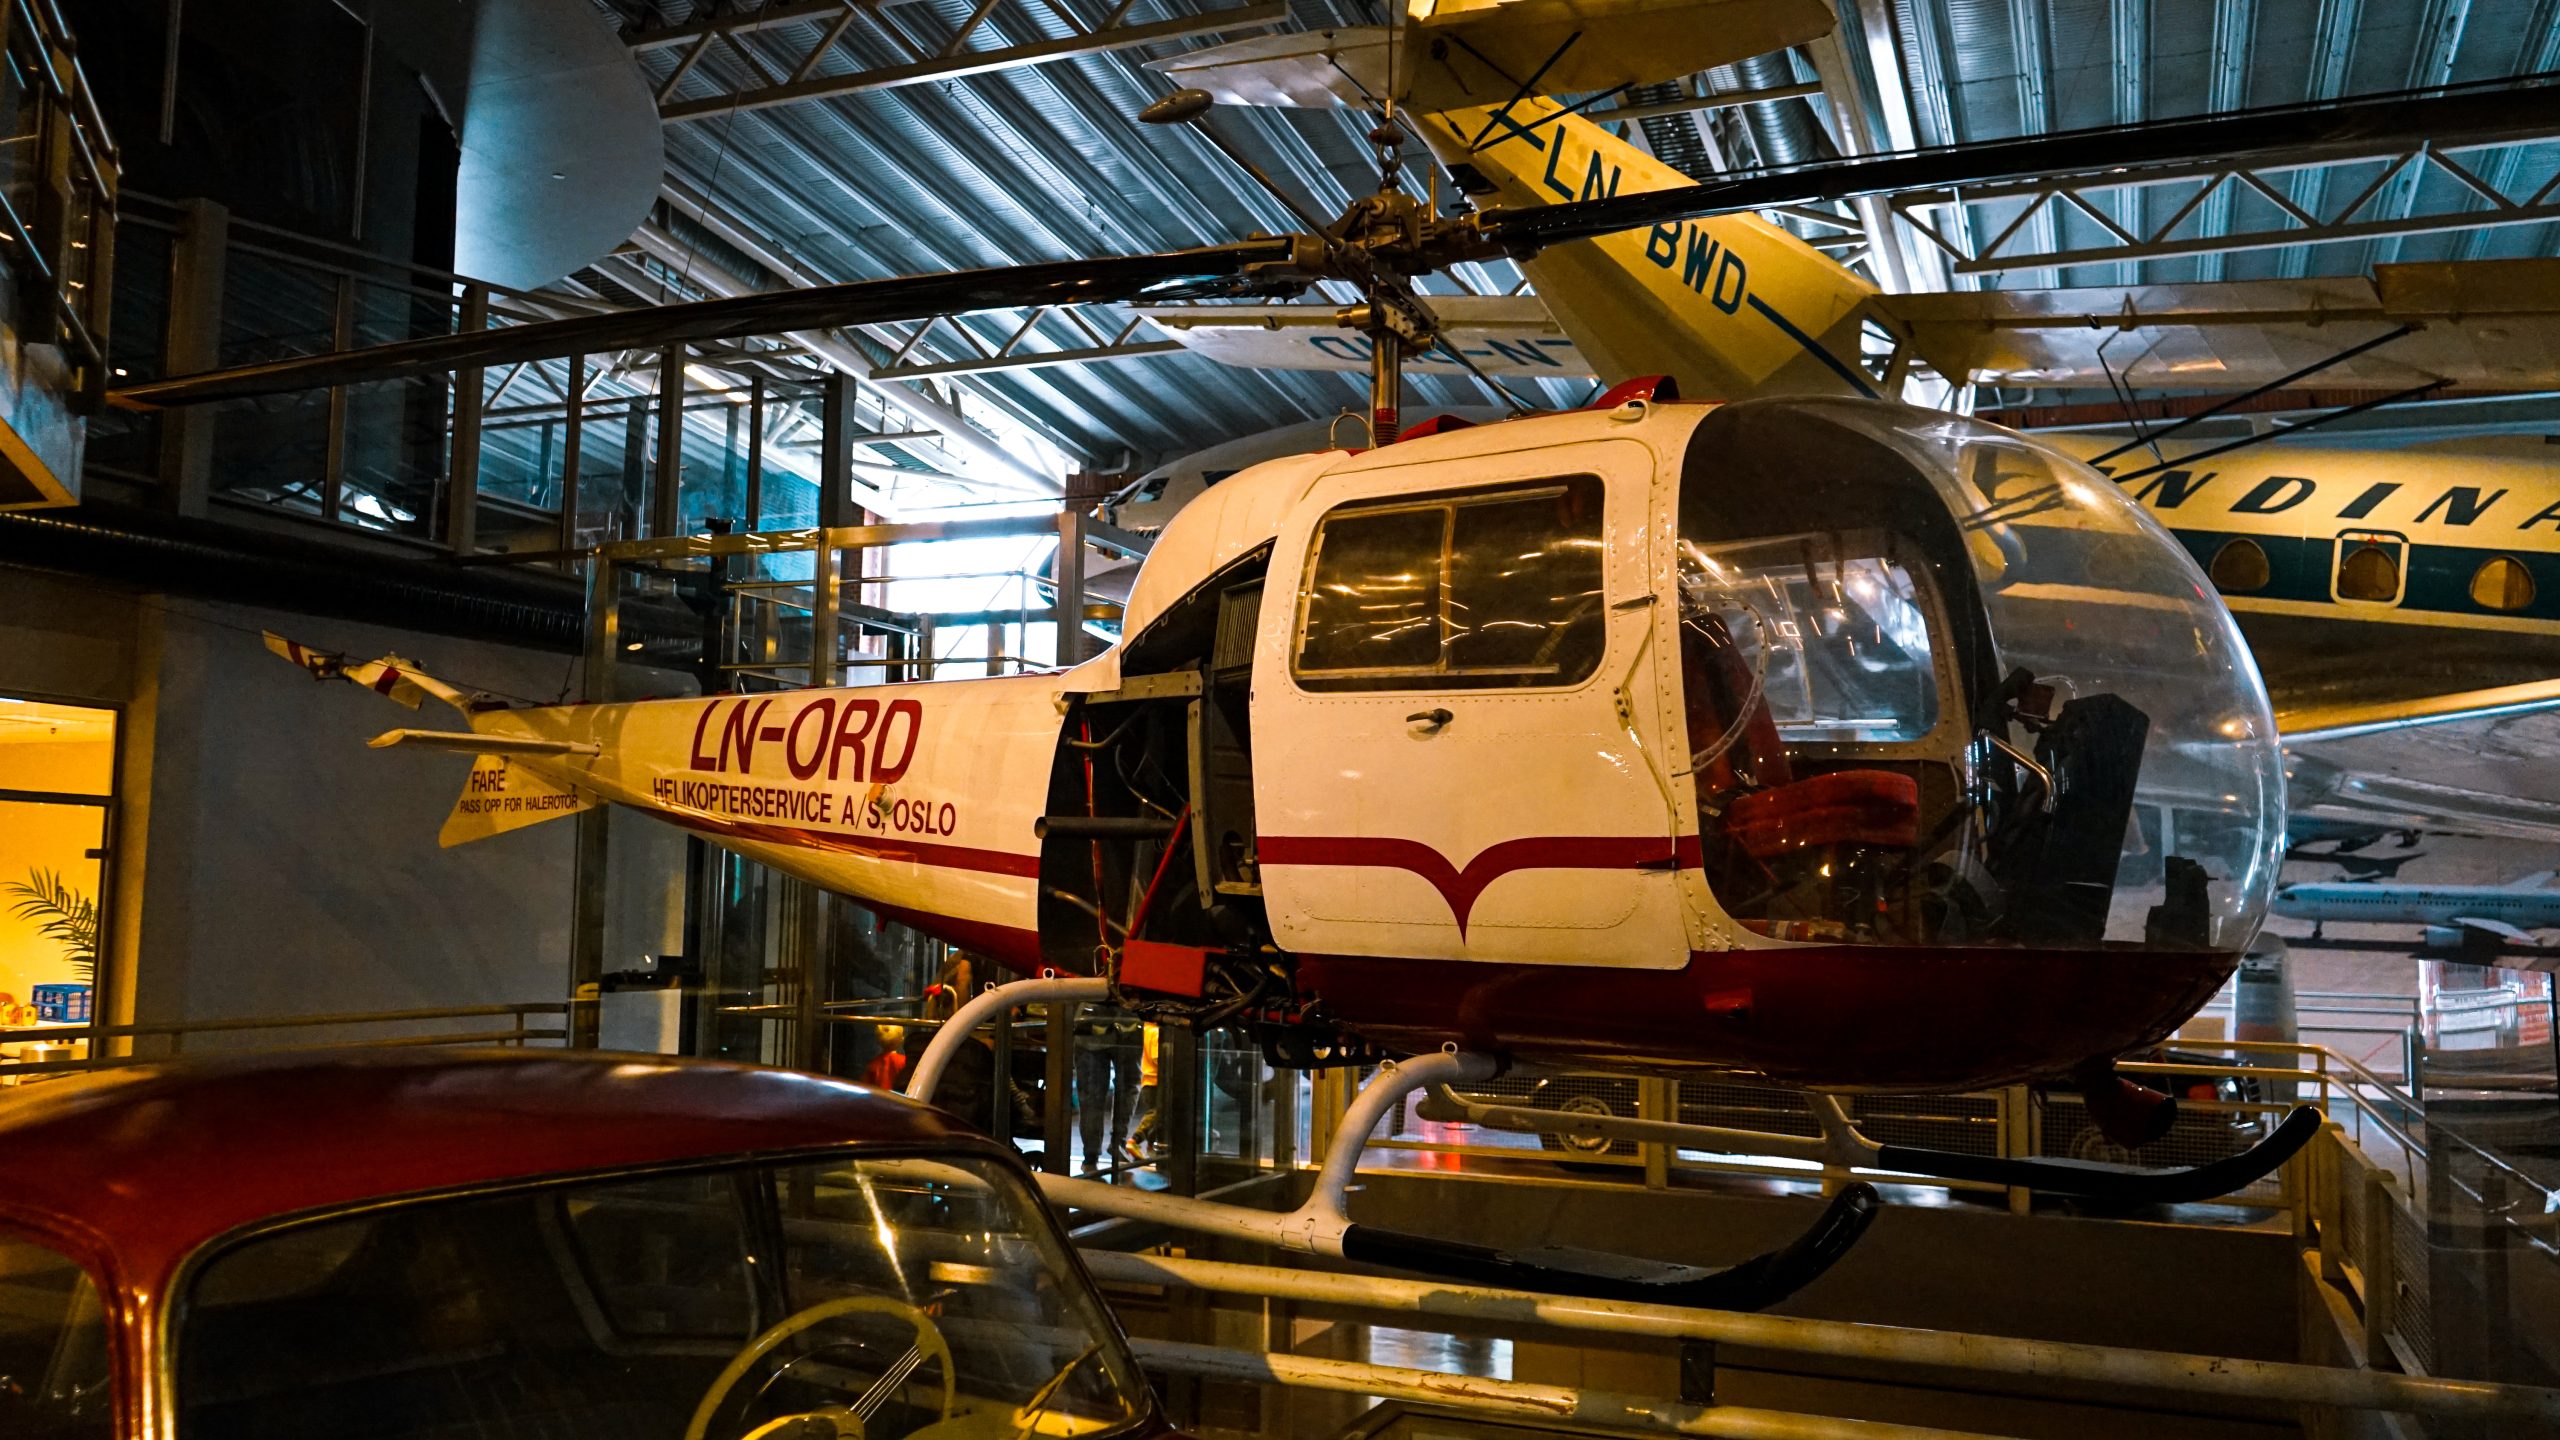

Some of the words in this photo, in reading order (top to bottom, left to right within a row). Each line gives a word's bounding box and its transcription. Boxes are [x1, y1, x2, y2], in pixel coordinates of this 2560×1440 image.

[690, 697, 923, 785] LN-ORD
[471, 769, 506, 793] FARE
[459, 799, 481, 814] PASS
[484, 798, 501, 813] OPP
[504, 797, 522, 812] FOR
[525, 794, 578, 811] HALEROTOR
[652, 777, 833, 823] HELIKOPTERSERVICE
[892, 799, 956, 837] OSLO
